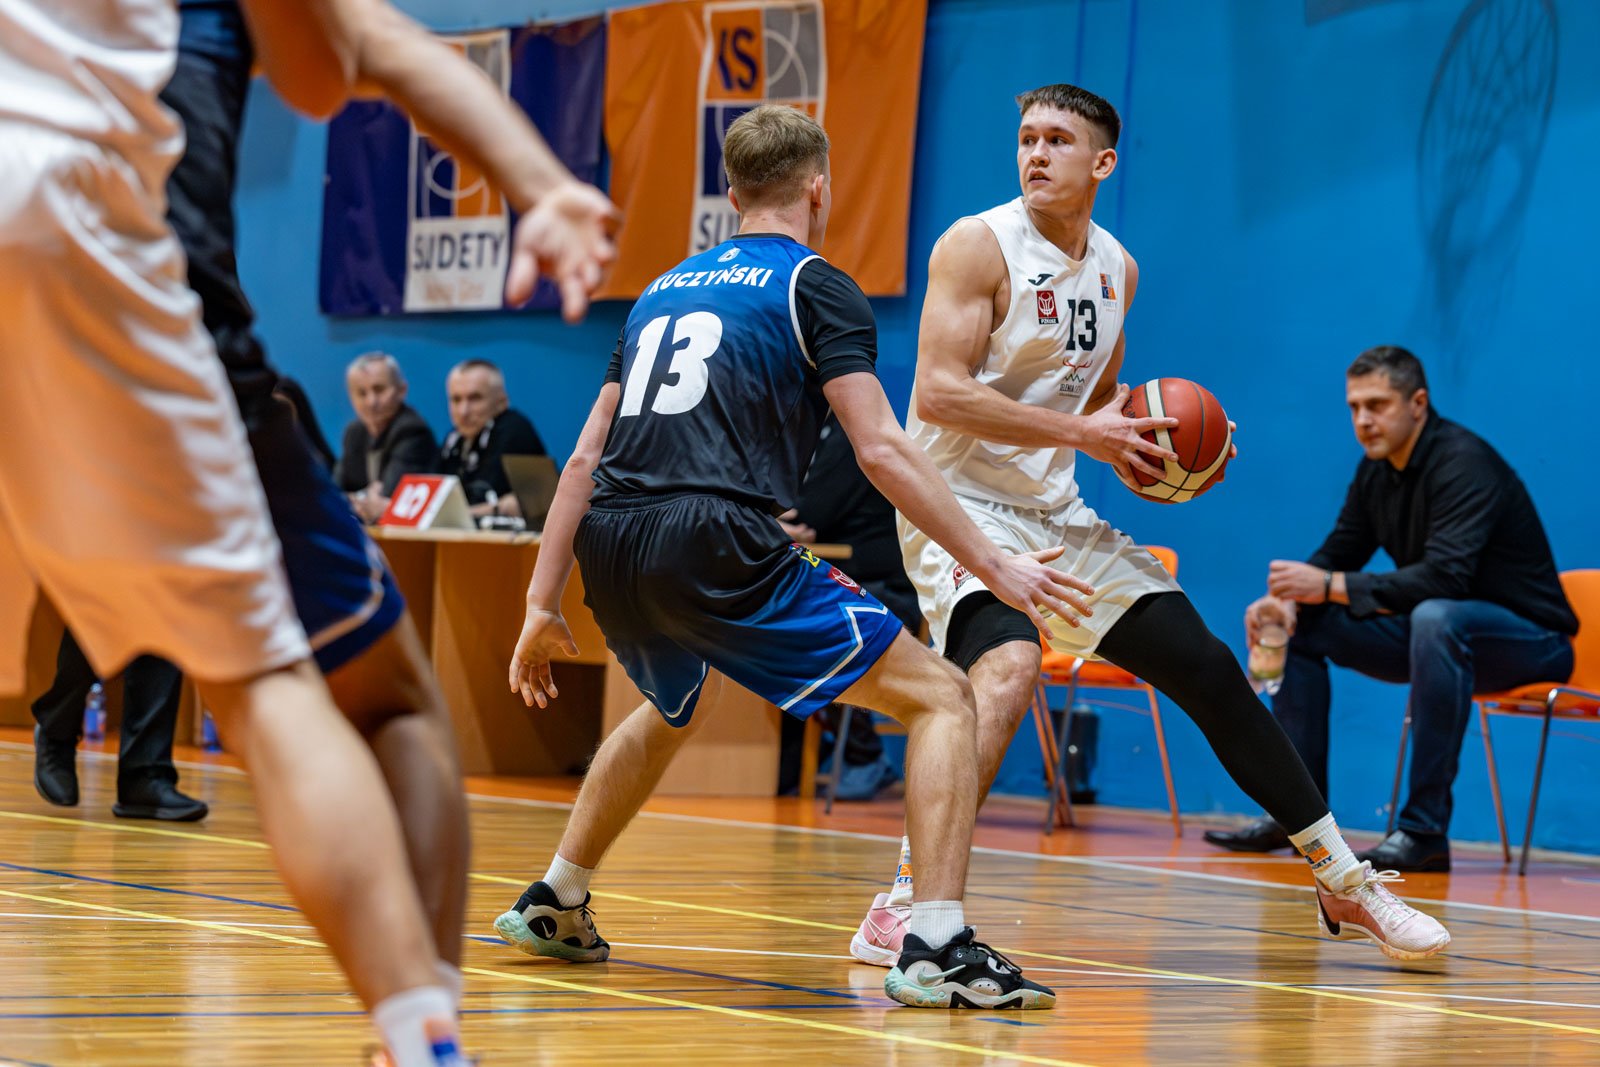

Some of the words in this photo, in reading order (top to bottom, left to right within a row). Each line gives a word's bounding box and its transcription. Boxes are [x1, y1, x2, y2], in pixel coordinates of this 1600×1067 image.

[647, 263, 774, 296] KUCZYŃSKI
[1065, 299, 1098, 352] 13
[620, 311, 724, 418] 13
